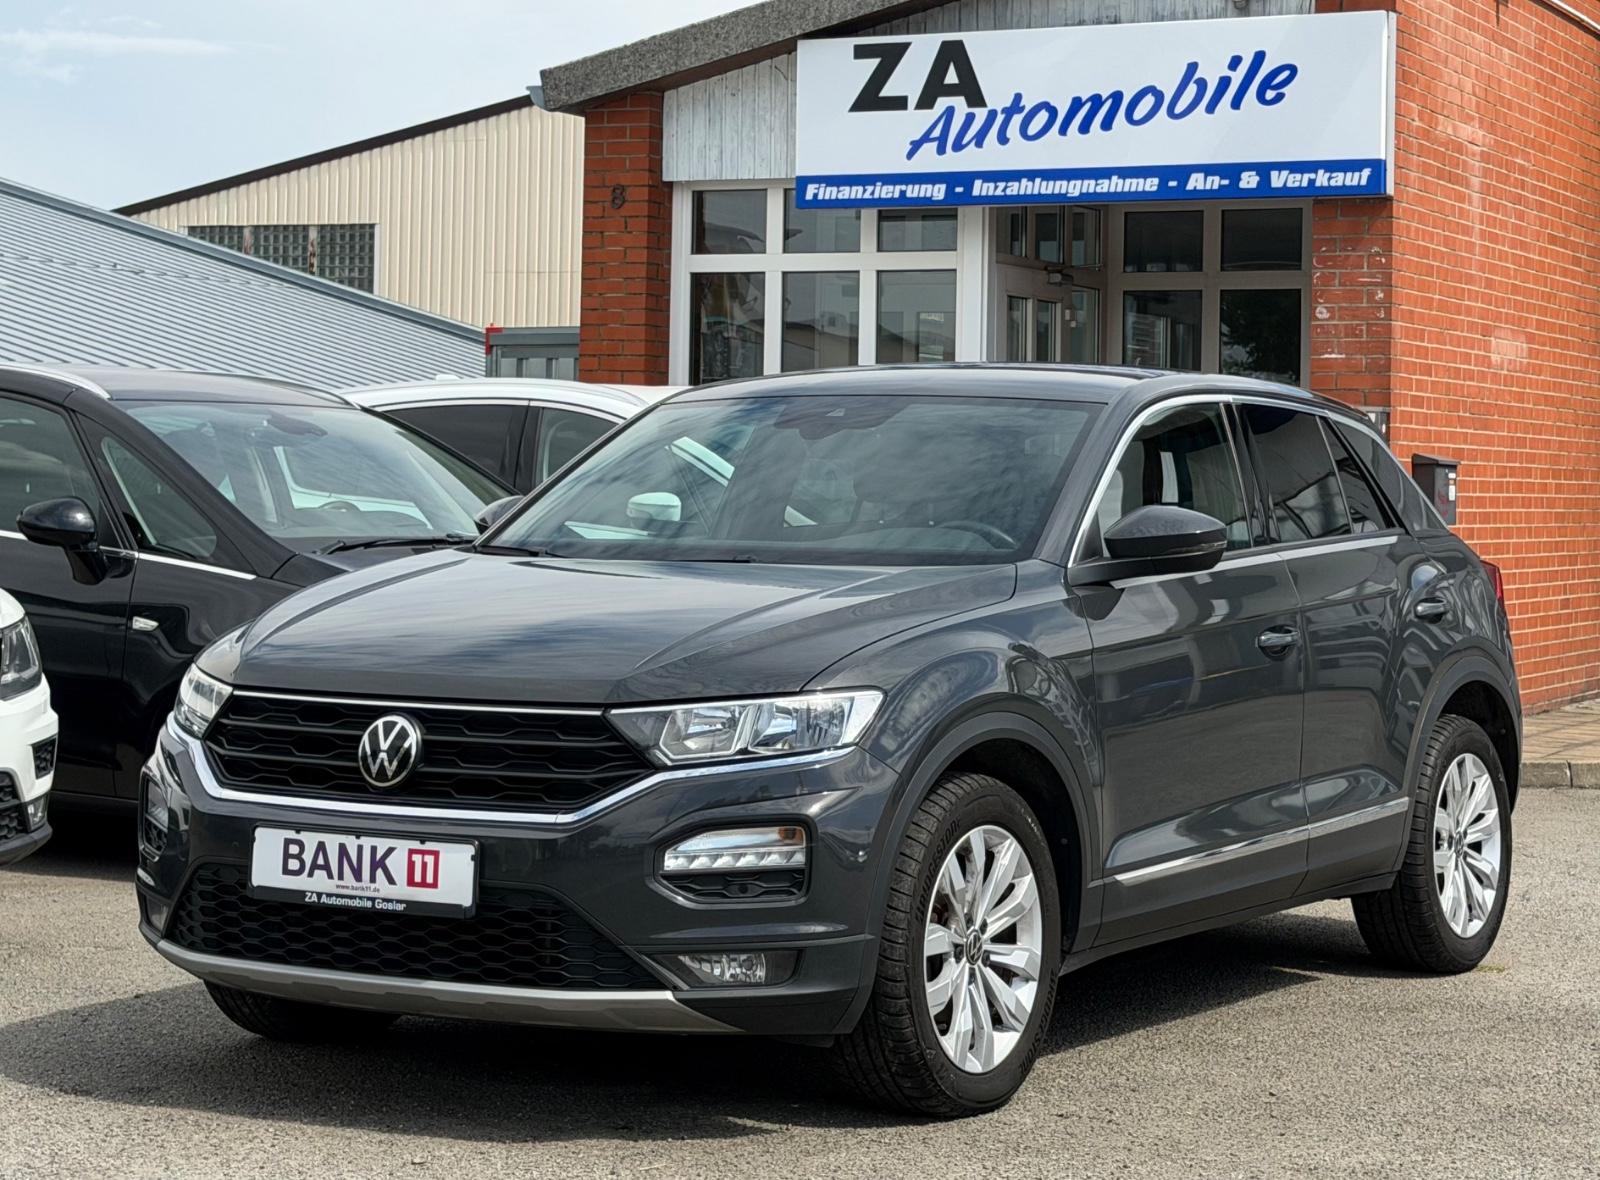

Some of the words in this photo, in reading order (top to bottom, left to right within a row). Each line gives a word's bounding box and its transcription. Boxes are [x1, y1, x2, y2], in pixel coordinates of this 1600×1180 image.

[849, 40, 987, 112] ZA
[906, 49, 1300, 161] Automobile
[805, 182, 947, 201] Finanzierung
[972, 175, 1159, 197] Inzahlungnahme
[1185, 172, 1230, 190] An-
[1238, 171, 1260, 189] &
[1270, 167, 1372, 188] Verkauf
[359, 715, 416, 787] VW
[281, 837, 398, 886] BANK
[411, 853, 435, 884] 11
[305, 892, 318, 902] ZA
[320, 894, 372, 908] Automobile
[375, 899, 406, 911] Goslar
